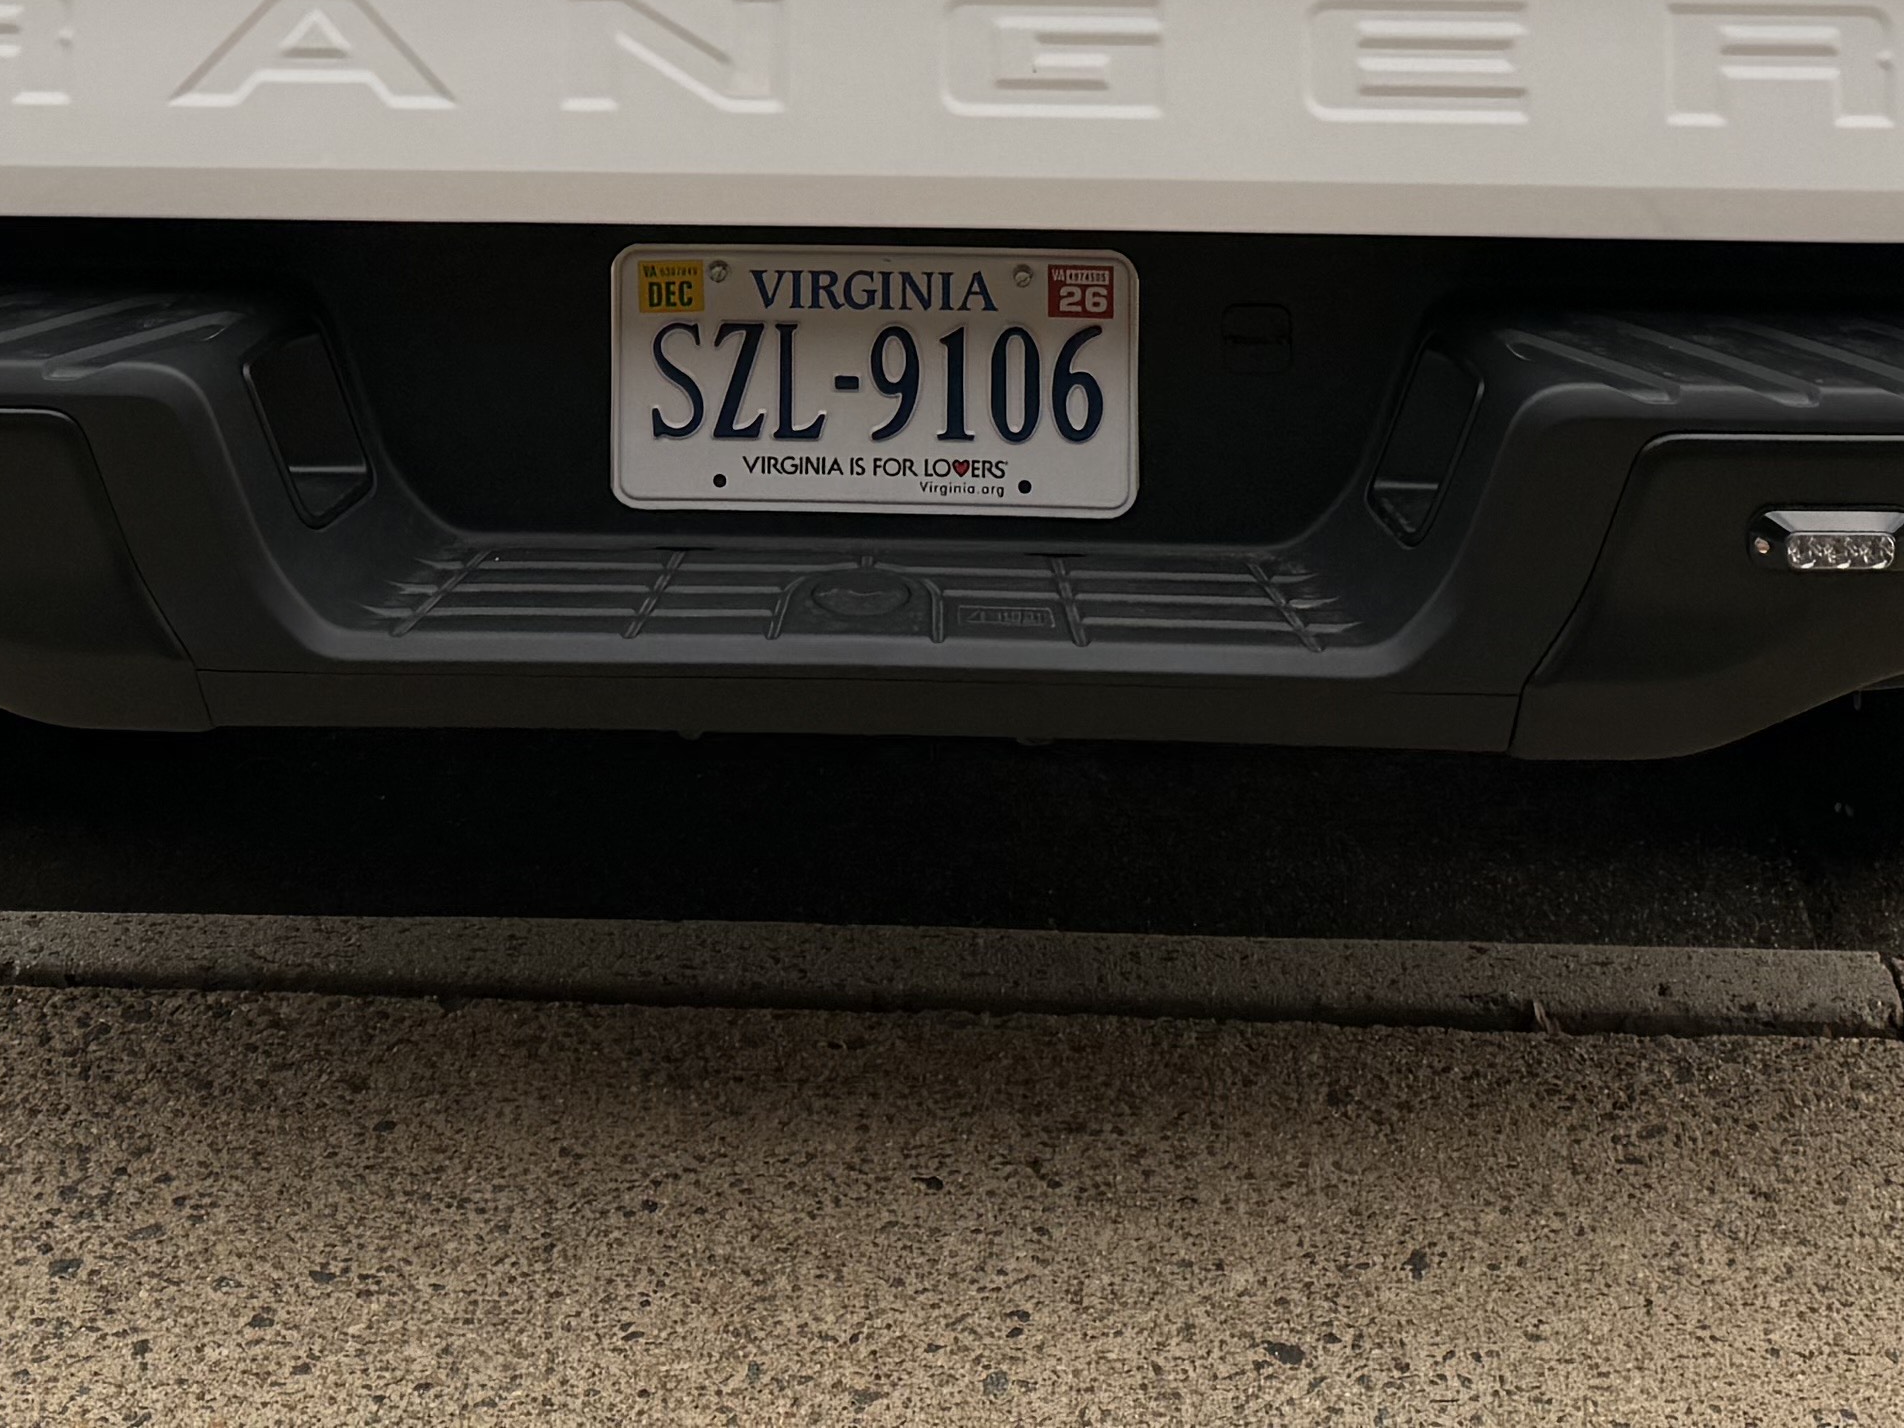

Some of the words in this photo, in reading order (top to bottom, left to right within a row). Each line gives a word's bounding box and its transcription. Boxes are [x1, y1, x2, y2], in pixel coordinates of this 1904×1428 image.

[643, 264, 658, 278] VA
[1051, 268, 1065, 282] VA
[648, 280, 694, 308] DEC
[748, 269, 999, 312] VIRGINIA
[1058, 286, 1108, 313] 26
[651, 321, 1104, 444] SZL-9106
[742, 455, 844, 475] VIRGINIA
[849, 457, 866, 476] IS
[872, 457, 919, 477] FOR
[919, 481, 1005, 498] Virginia.org
